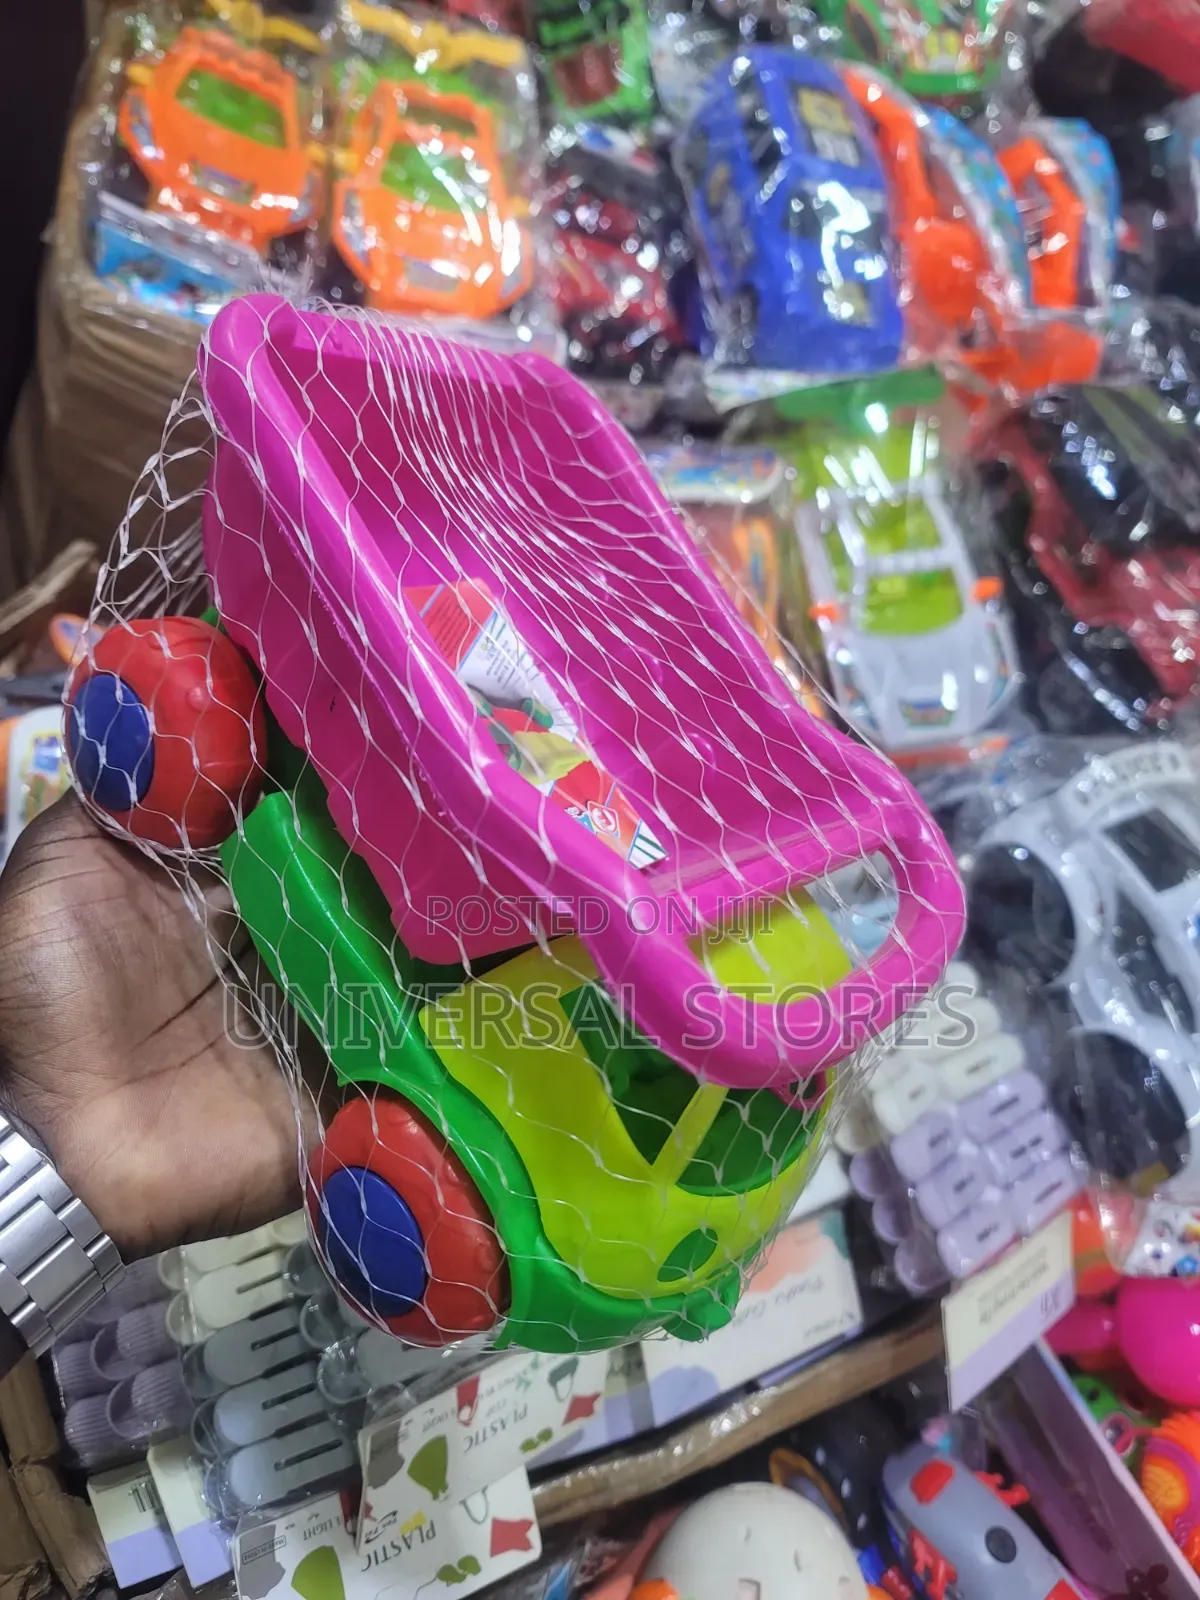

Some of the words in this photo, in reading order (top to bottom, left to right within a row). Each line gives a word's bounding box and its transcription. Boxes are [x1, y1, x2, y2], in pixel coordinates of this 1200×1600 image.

[463, 1402, 528, 1453] PLASTIC
[302, 1519, 336, 1541] LIGHT
[361, 1519, 436, 1572] PLASTIC
